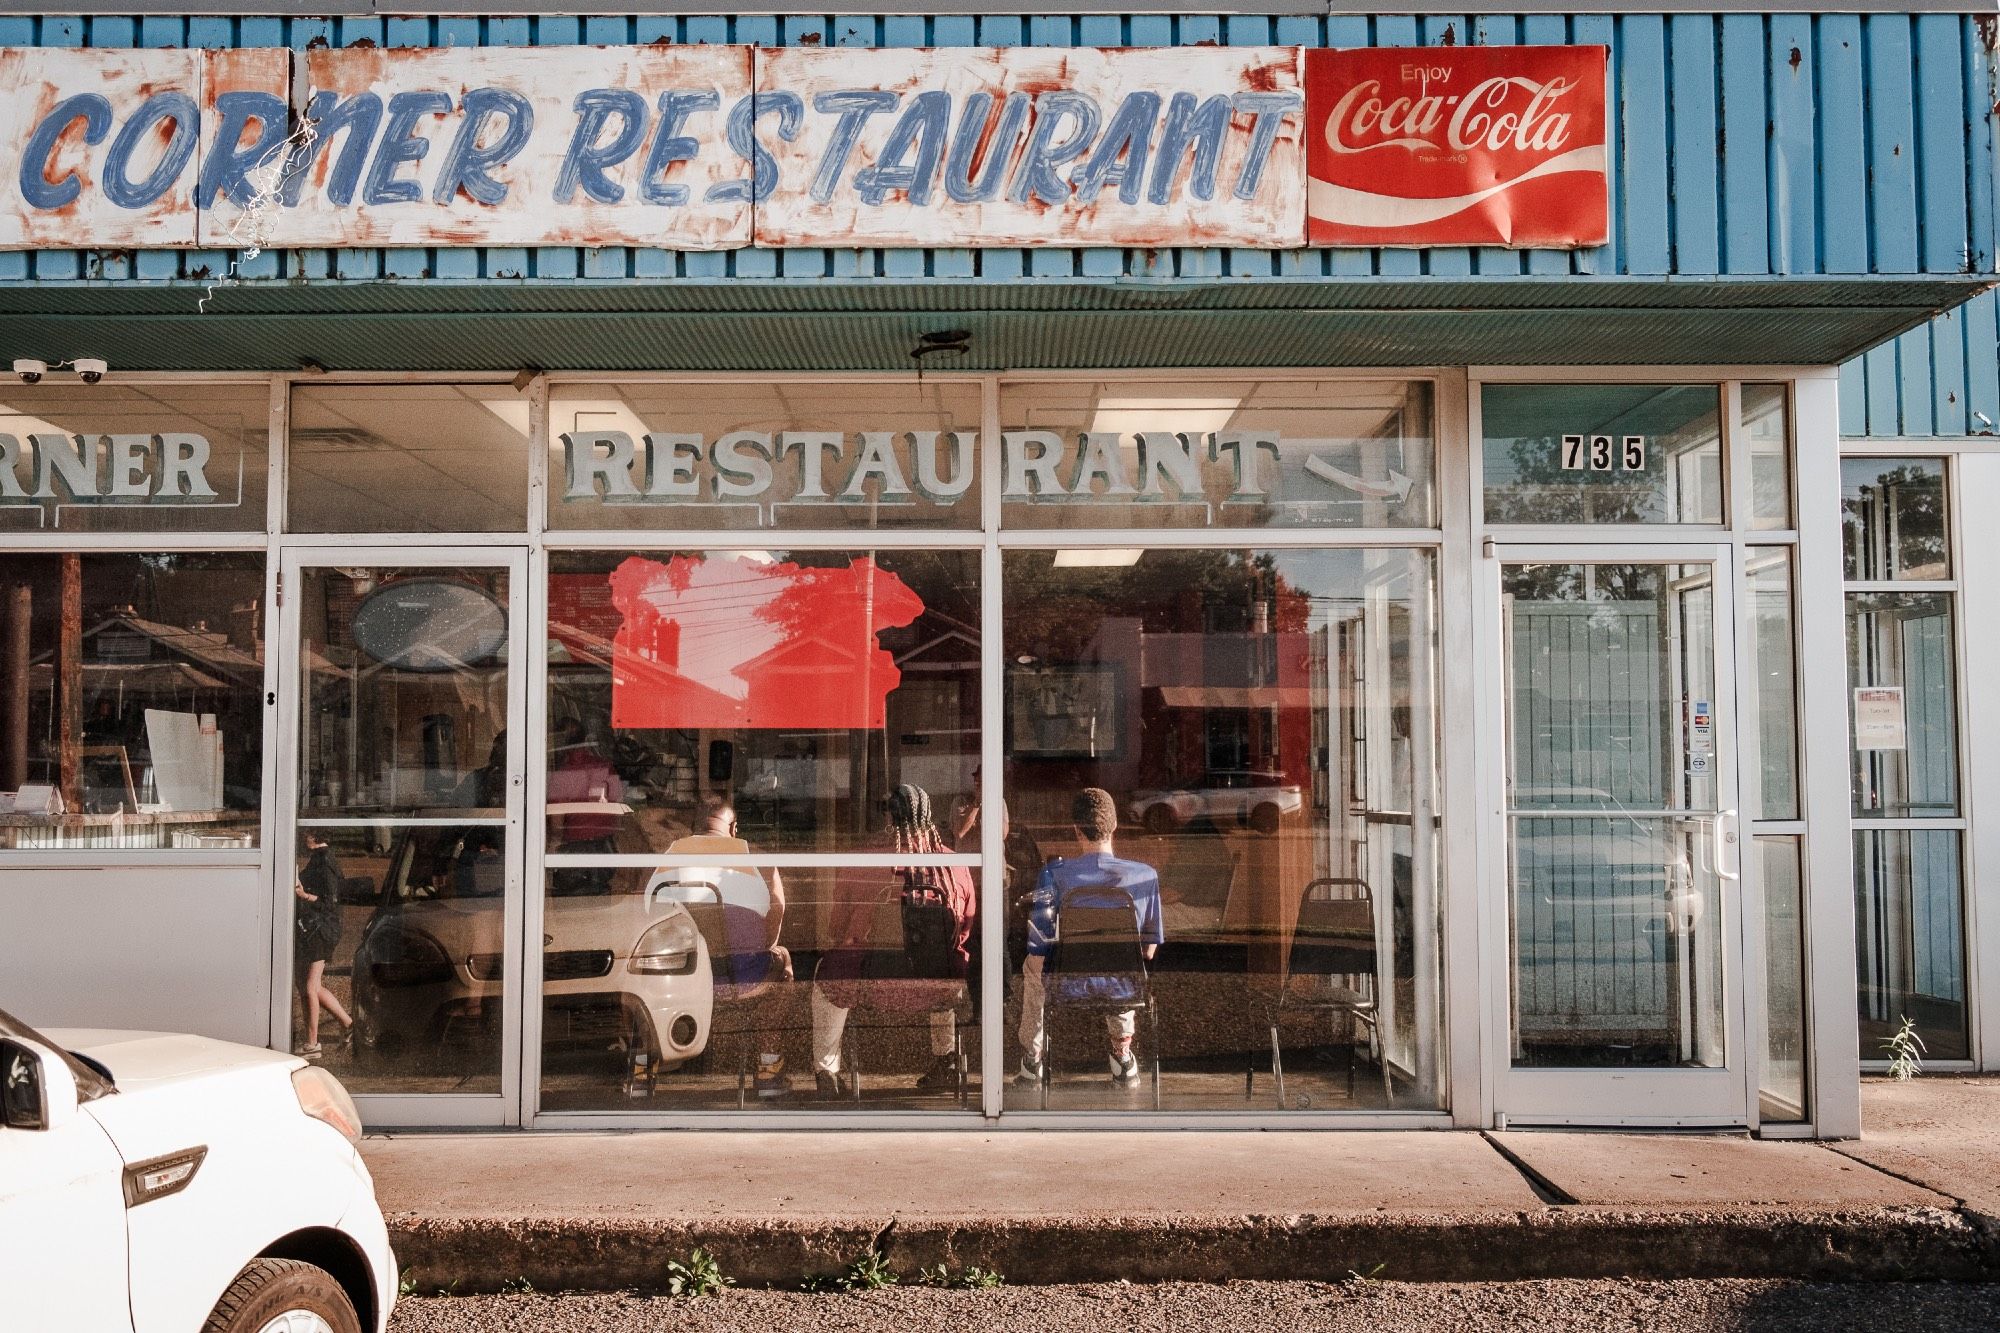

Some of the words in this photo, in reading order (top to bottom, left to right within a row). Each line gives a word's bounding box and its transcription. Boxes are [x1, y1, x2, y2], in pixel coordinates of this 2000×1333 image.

[1401, 63, 1452, 83] Enjoy
[1325, 76, 1583, 154] Coca-Cola
[19, 87, 534, 210] CORNER
[552, 87, 1304, 208] RESTAURANT
[1563, 436, 1643, 470] 735
